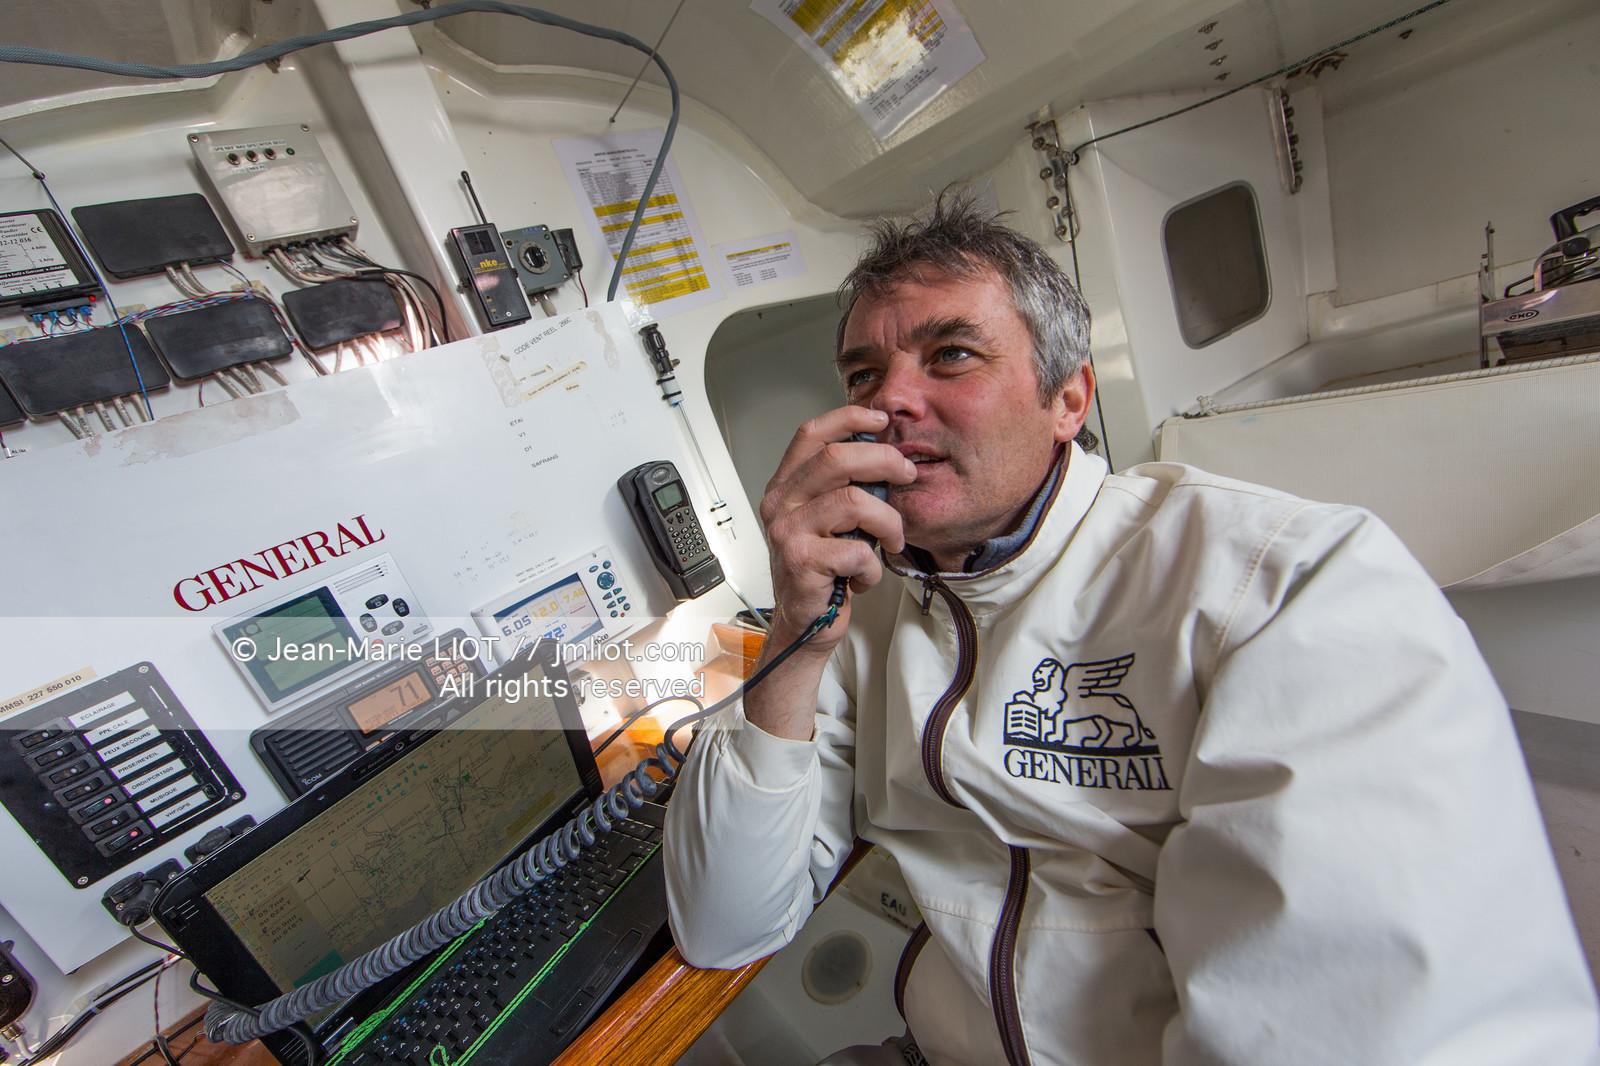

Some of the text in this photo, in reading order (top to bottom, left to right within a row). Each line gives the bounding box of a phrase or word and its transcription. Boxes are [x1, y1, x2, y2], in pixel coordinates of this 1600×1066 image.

[480, 259, 498, 268] nke
[514, 342, 530, 354] CODE
[529, 334, 544, 345] VENT
[543, 326, 557, 336] REEL
[532, 454, 559, 468] SAFRANS
[174, 514, 385, 612] GENERAL
[532, 601, 559, 621] 12.0
[502, 614, 532, 636] 6.05
[0, 675, 81, 713] MMSI 227 550 010
[390, 680, 419, 706] 71
[80, 701, 116, 721] ECLAIRAGE
[99, 719, 129, 736] PPE CALE
[103, 731, 151, 757] FEUX SECOURS
[118, 751, 159, 773] PRISE/REVEIL
[1004, 748, 1173, 790] GENERALI
[150, 787, 177, 804] MUSIQUE
[165, 802, 190, 818] VHF/GPS
[881, 892, 906, 916] EAU
